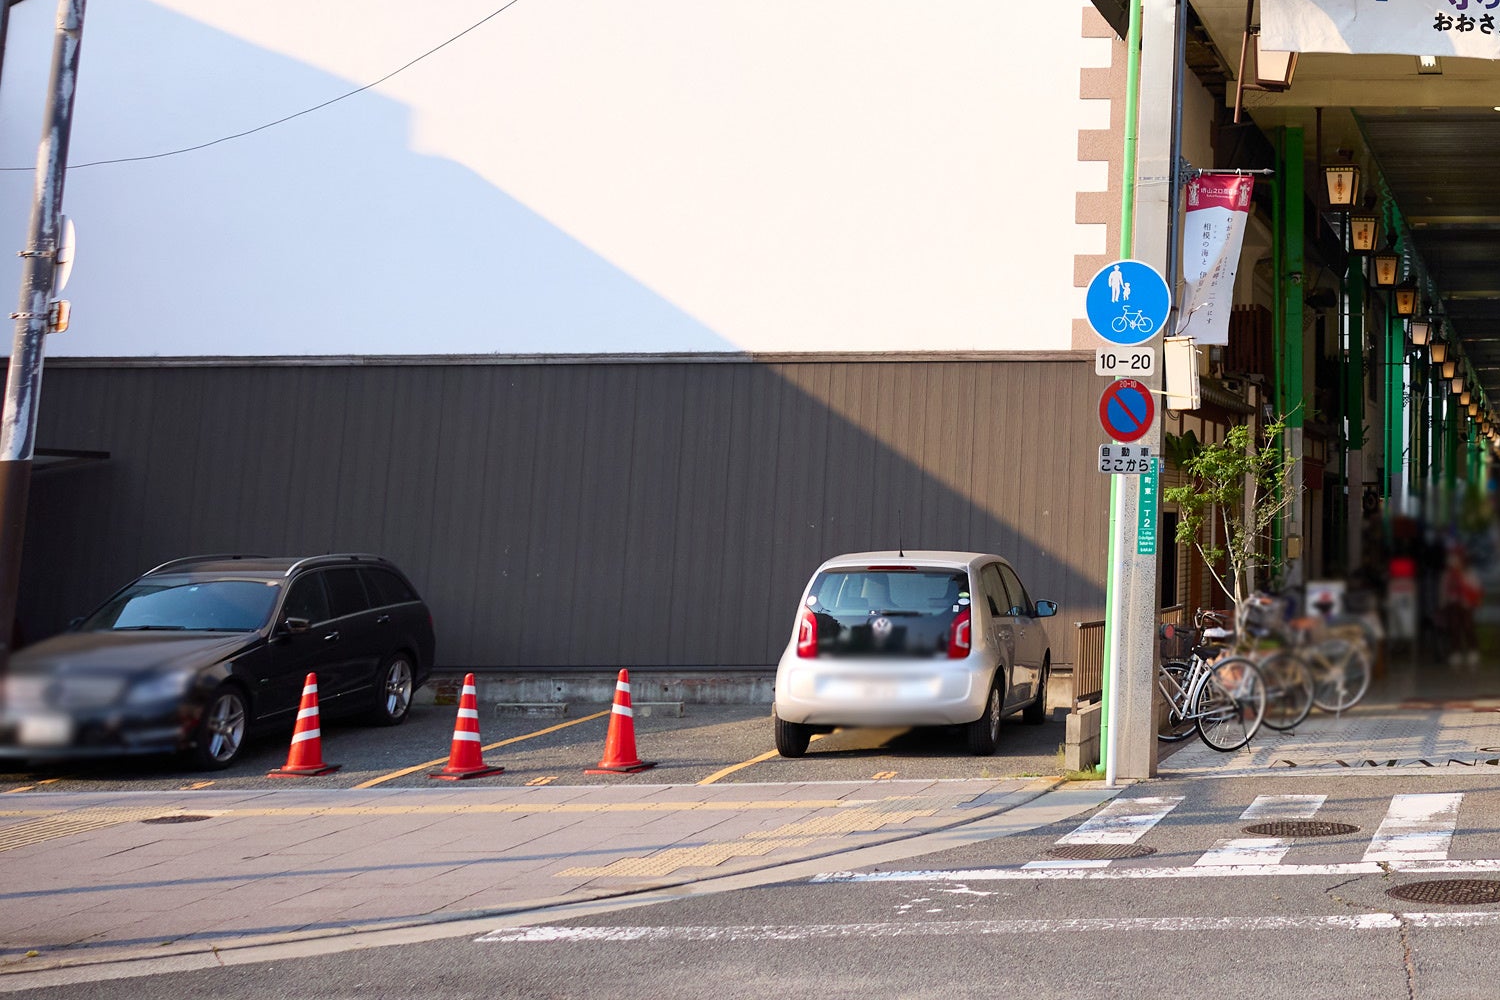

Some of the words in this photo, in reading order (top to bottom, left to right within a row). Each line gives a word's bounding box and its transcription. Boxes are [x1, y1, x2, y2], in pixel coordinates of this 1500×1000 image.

[1100, 353, 1151, 370] 10-20
[1119, 380, 1137, 389] 20-10
[1102, 447, 1149, 457] 自動車
[1101, 459, 1149, 472] ここから
